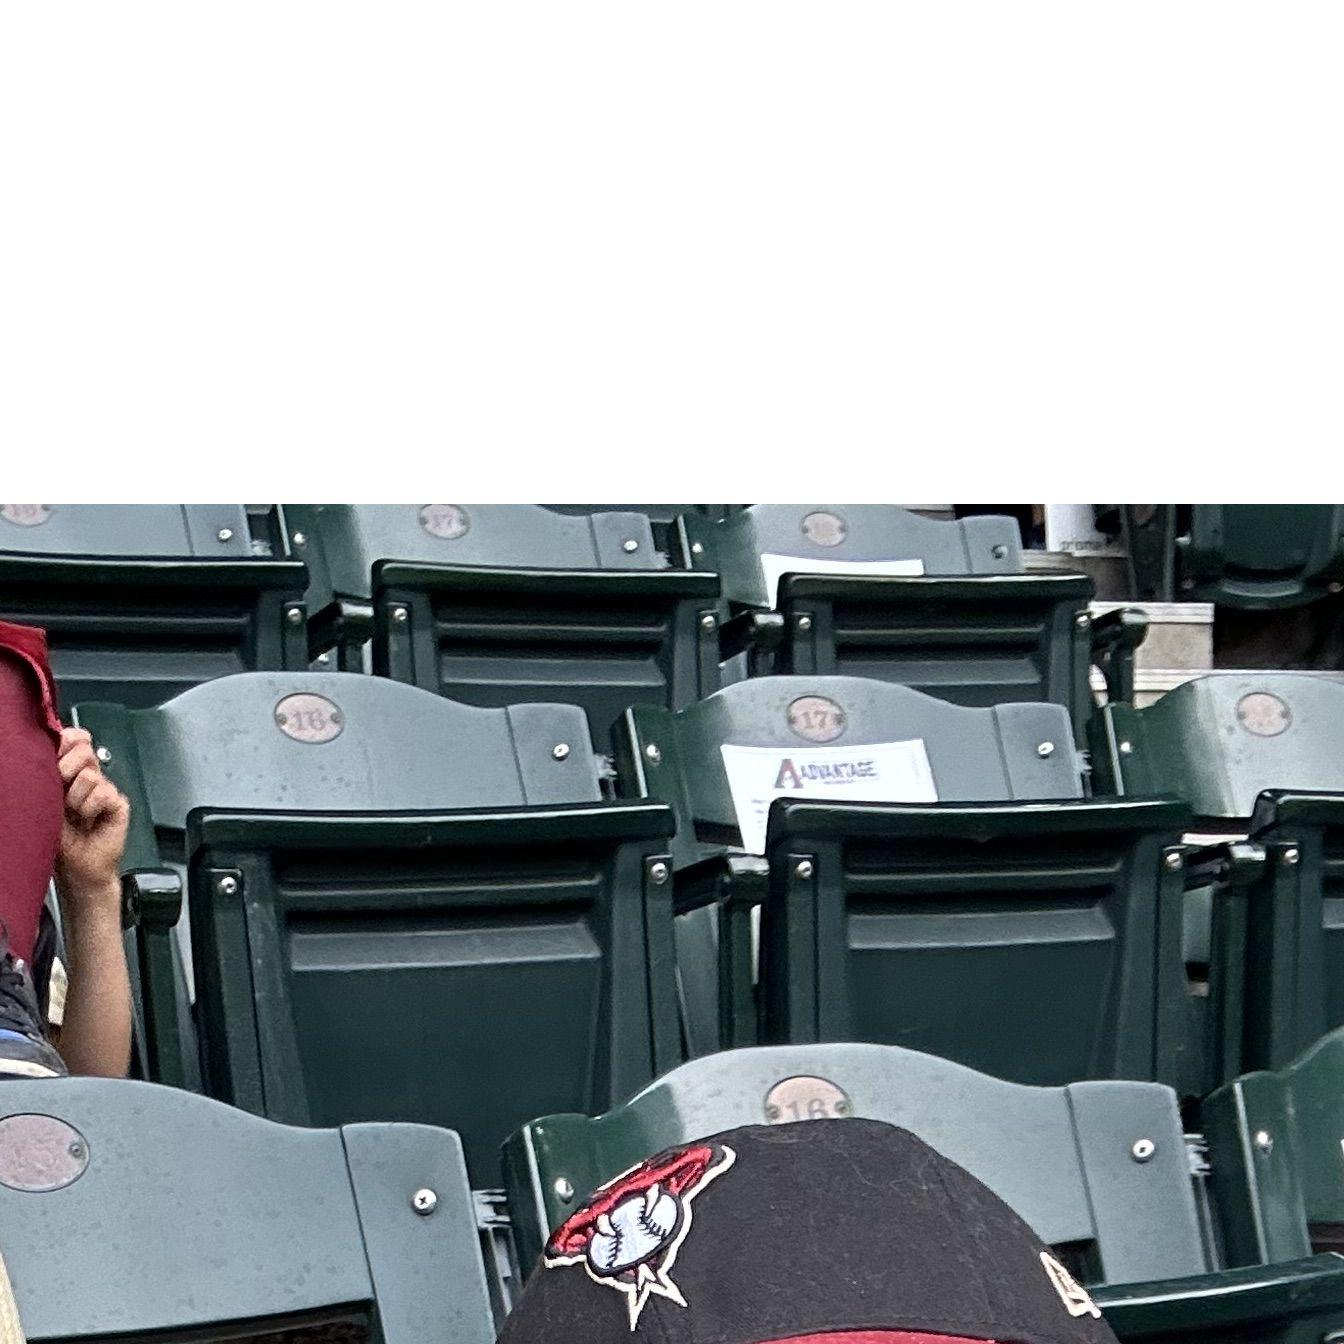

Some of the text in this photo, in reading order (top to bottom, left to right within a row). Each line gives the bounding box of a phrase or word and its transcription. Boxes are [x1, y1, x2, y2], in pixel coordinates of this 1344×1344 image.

[293, 708, 327, 731] 16
[801, 711, 829, 730] 17
[785, 1099, 829, 1120] 16
